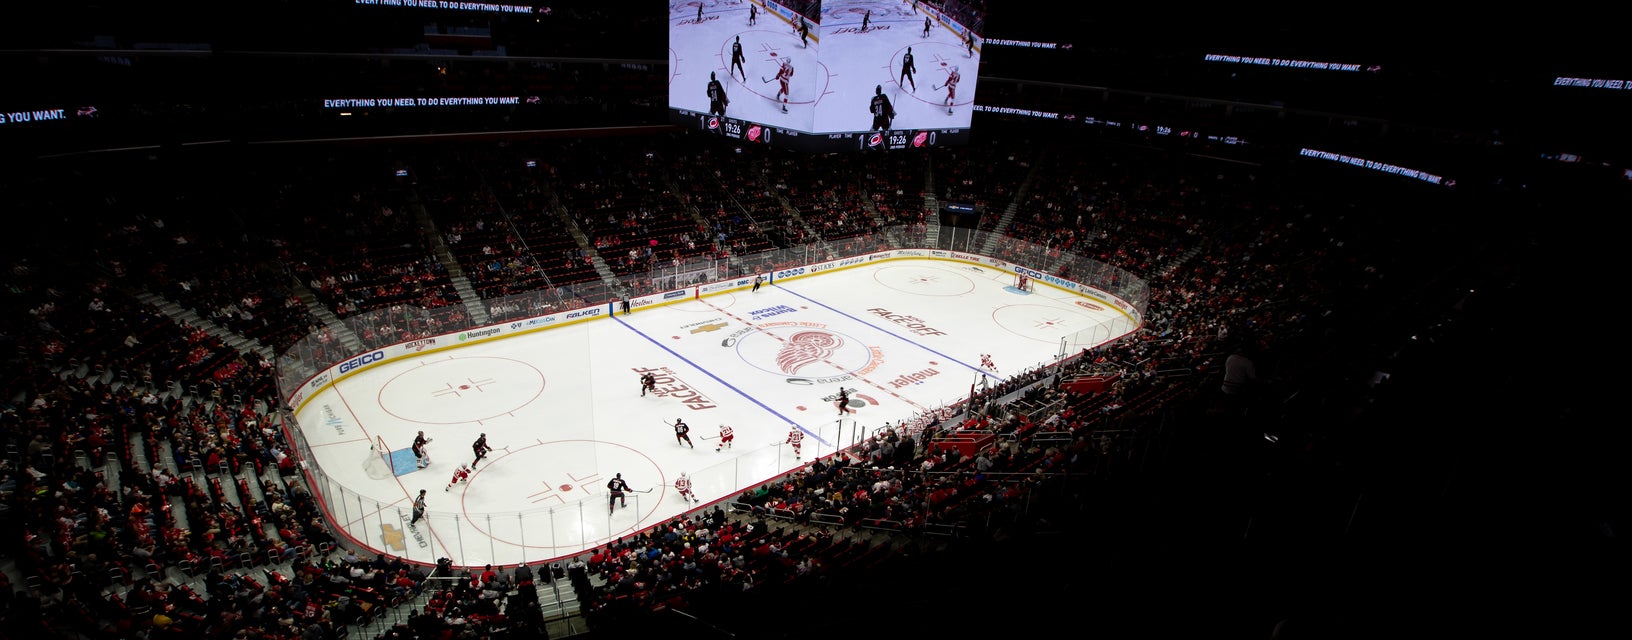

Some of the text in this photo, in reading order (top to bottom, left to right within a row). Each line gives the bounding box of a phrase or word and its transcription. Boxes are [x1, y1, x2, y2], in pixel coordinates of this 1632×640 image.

[419, 0, 438, 8] NEED,
[460, 2, 499, 11] EVERYTHING
[1000, 39, 1030, 47] EVERYTHING
[1205, 54, 1240, 63] EVERYTHING
[1290, 60, 1328, 69] EVERYTHING
[1554, 77, 1592, 87] EVERYTHING
[1591, 79, 1606, 88] YOU
[1604, 79, 1624, 90] NEED,
[325, 99, 375, 107] EVERYTHING
[394, 98, 415, 106] NEED,
[8, 112, 30, 122] YOU
[33, 109, 66, 120] WANT.
[1000, 107, 1031, 116] EVERYTHING
[700, 115, 704, 130] 1
[725, 122, 740, 134] 19:26
[764, 127, 771, 143] 0
[1157, 126, 1172, 134] 19:26
[859, 134, 864, 150] 1
[889, 135, 906, 145] 19:26
[929, 131, 936, 145] 0
[1300, 148, 1442, 184] EVERYTHING YOU NEED, TO DO EVERYTHING YOU WANT.
[566, 308, 600, 319] FALKEN
[467, 327, 500, 340] Huntington
[405, 339, 436, 350] HOCKEYTOWN
[339, 350, 384, 374] GEICO
[816, 375, 853, 385] arena
[820, 387, 858, 403] BEOR
